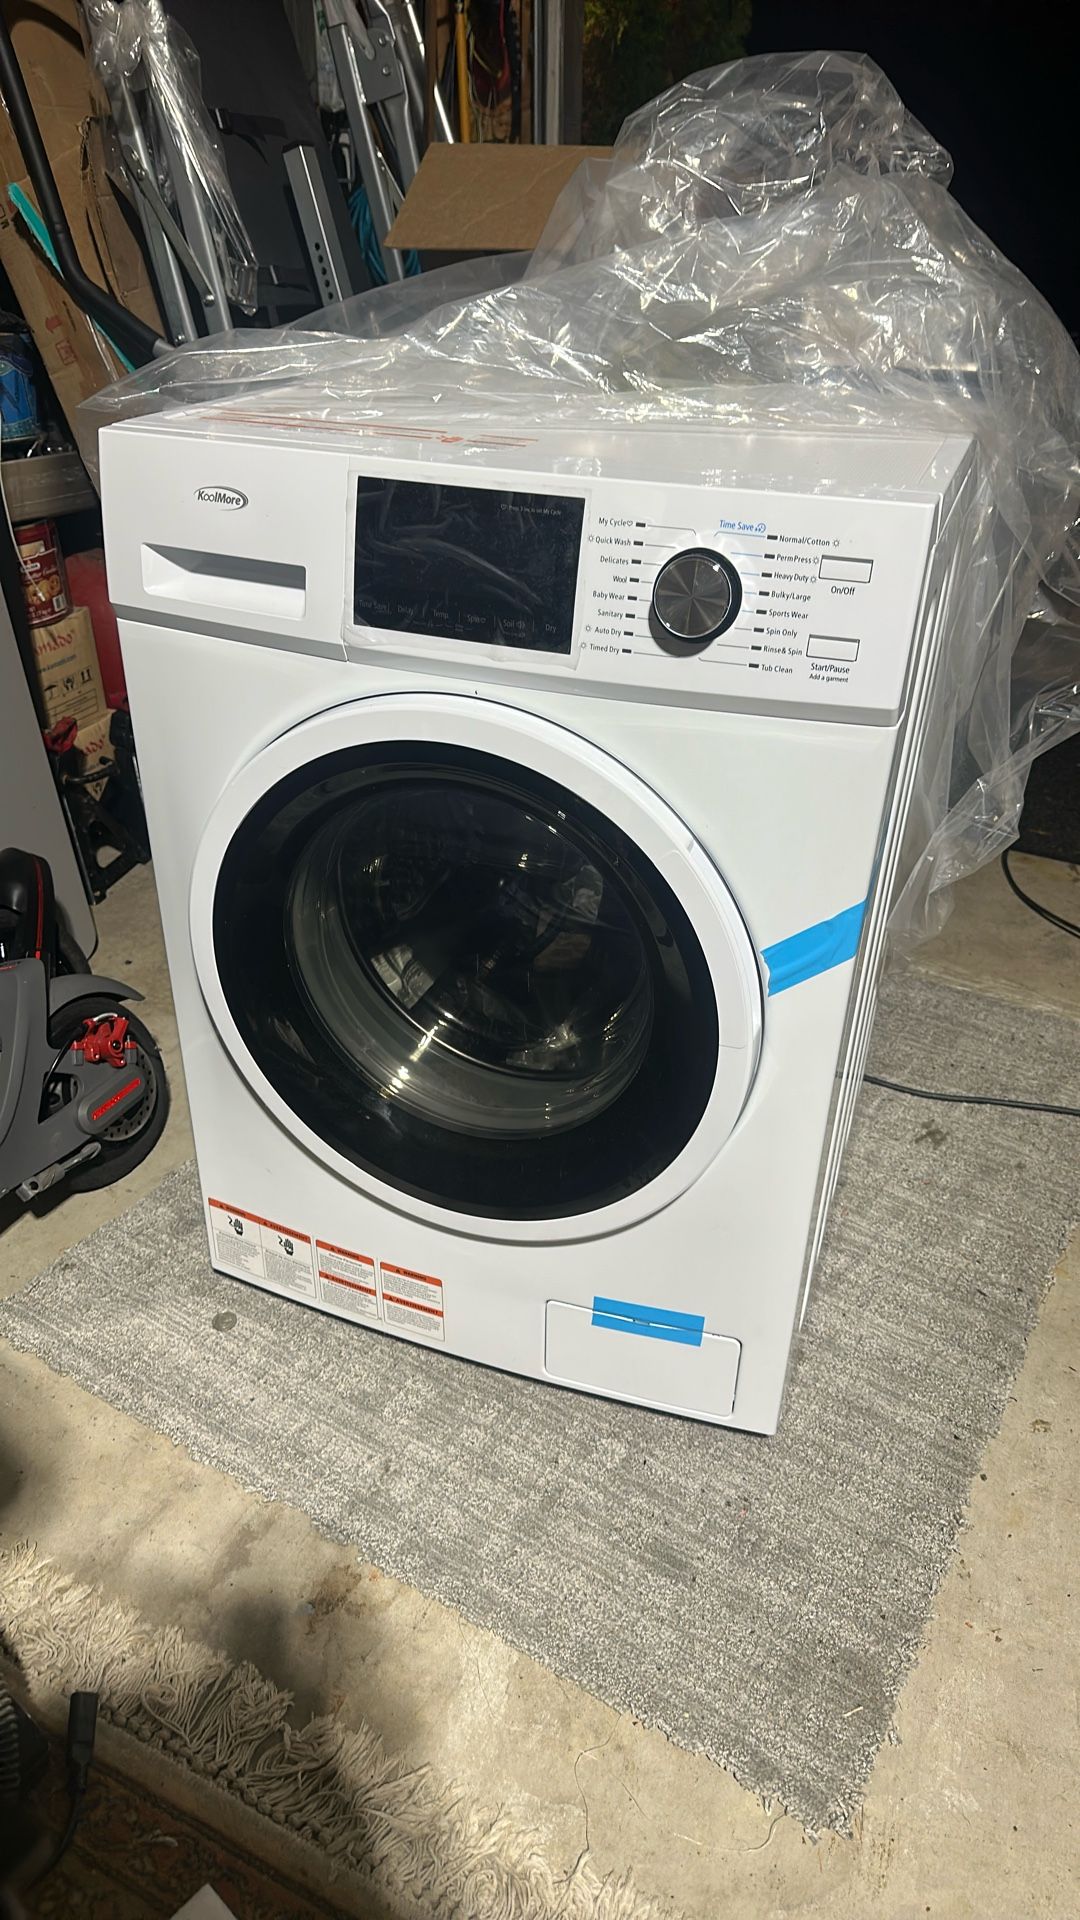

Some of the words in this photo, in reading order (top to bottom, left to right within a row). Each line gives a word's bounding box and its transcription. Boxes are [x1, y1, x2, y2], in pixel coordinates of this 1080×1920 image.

[197, 490, 241, 505] KoolMore
[598, 517, 608, 526] My
[609, 518, 627, 528] Cycle
[719, 519, 736, 530] Time
[738, 521, 754, 532] Save
[595, 536, 613, 546] Quick
[614, 538, 631, 546] Wash
[779, 535, 830, 547] Normal/Cotton
[600, 555, 629, 565] Delicates
[613, 575, 627, 583] Wool
[773, 571, 793, 583] Heavy
[793, 573, 809, 583] Duty
[592, 590, 608, 600] Baby
[608, 592, 625, 601] Wear
[830, 585, 856, 596] On/Off
[771, 590, 811, 603] Bulky/Large
[597, 608, 624, 619] Sanitary
[768, 608, 790, 619] Sports
[791, 610, 809, 620] Wear
[594, 626, 610, 635] Auto
[610, 628, 622, 638] Dry
[766, 627, 781, 637] Spin
[782, 628, 798, 638] Only
[590, 643, 608, 653] Timed
[609, 645, 620, 655] Dry
[788, 646, 803, 656] Spin
[761, 664, 773, 672] Tub
[774, 665, 793, 674] Clean
[810, 662, 850, 674] Start/Pause
[809, 673, 821, 681] Add
[825, 675, 849, 683] garment
